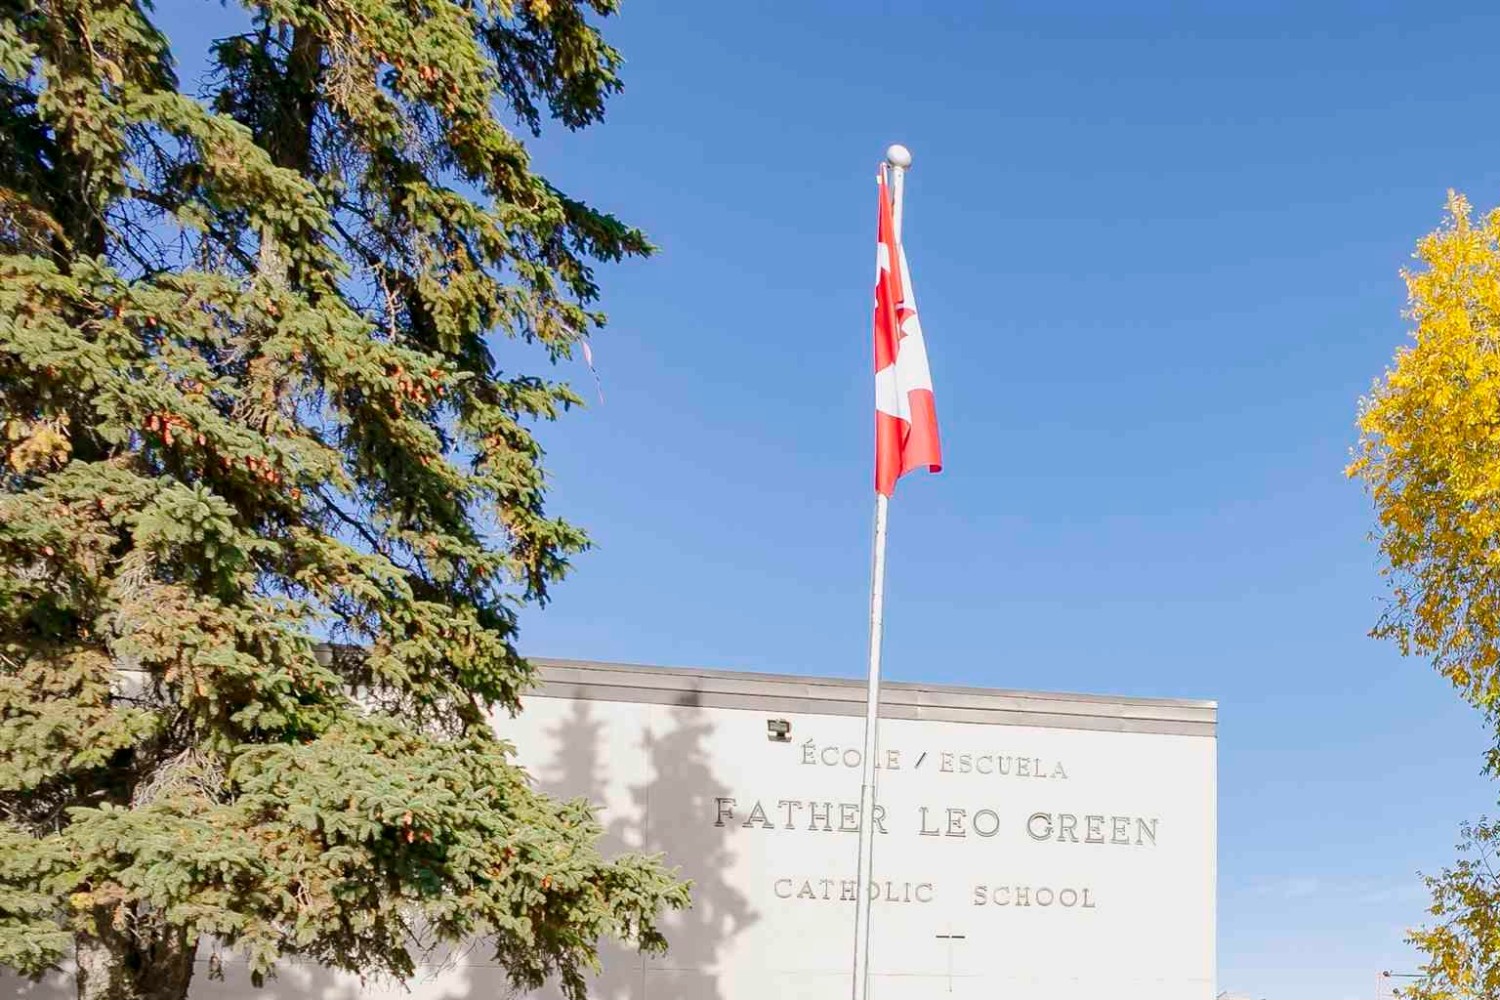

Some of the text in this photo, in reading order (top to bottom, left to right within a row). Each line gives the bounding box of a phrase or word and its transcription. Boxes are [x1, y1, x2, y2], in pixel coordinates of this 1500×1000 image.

[801, 739, 900, 770] ÉCOE
[939, 752, 1068, 780] ESCUELA
[713, 797, 1159, 846] FATHER LEO GREEN
[973, 885, 1096, 908] SCHOOL
